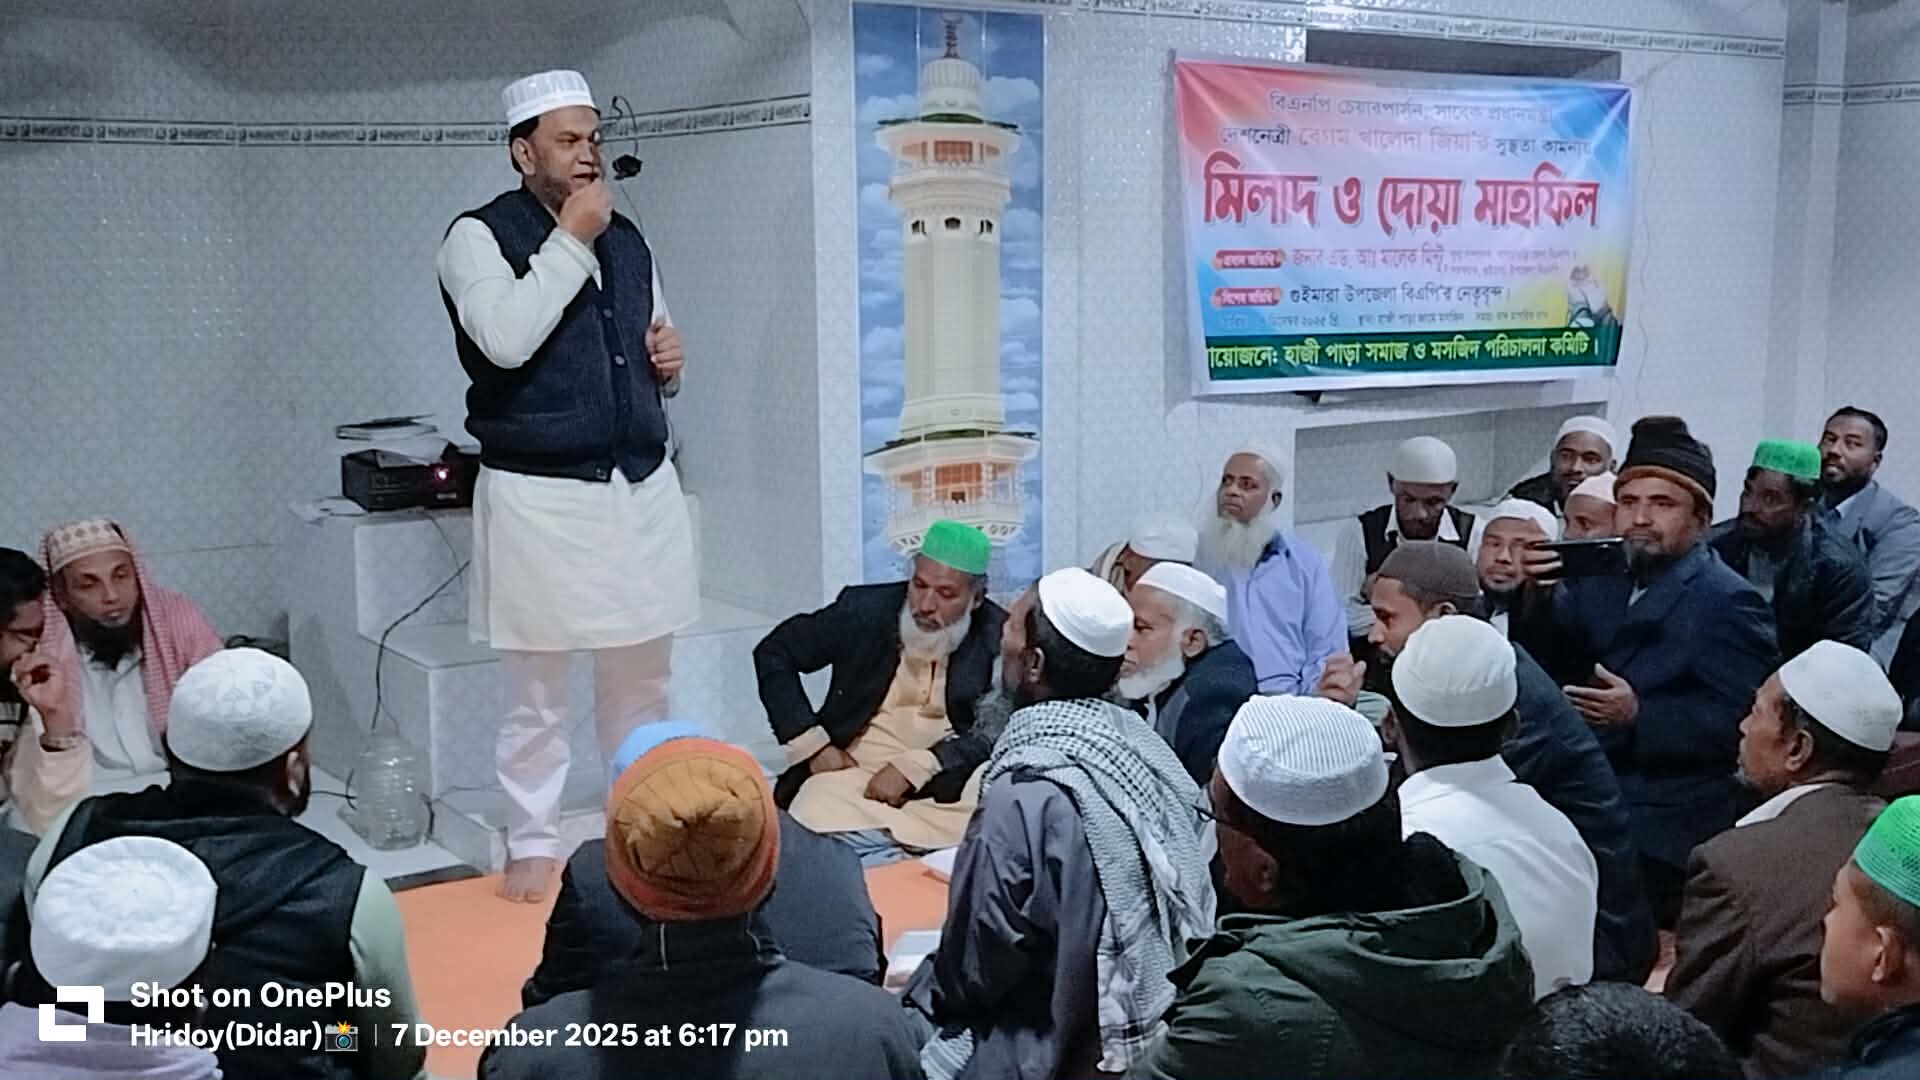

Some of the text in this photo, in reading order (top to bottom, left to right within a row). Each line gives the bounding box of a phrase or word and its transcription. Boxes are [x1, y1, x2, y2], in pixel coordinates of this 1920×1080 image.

[1269, 90, 1331, 112] বিএনপি
[1218, 123, 1291, 145] দেশনেত্রী
[1299, 127, 1351, 145] বেগম
[1358, 128, 1422, 150] খালেদা
[1203, 150, 1601, 238] মিলাদ ও দোয়া মাহফিল
[1289, 284, 1340, 303] গুইমারা
[1344, 284, 1397, 302] উপজেলা
[1283, 337, 1321, 368] হাজী
[1325, 343, 1361, 367] পাড়া
[1365, 342, 1409, 362] সমাজ
[1413, 342, 1426, 360] ও
[1430, 334, 1482, 360] মসজিদ
[1484, 333, 1548, 359] পরিচালনা
